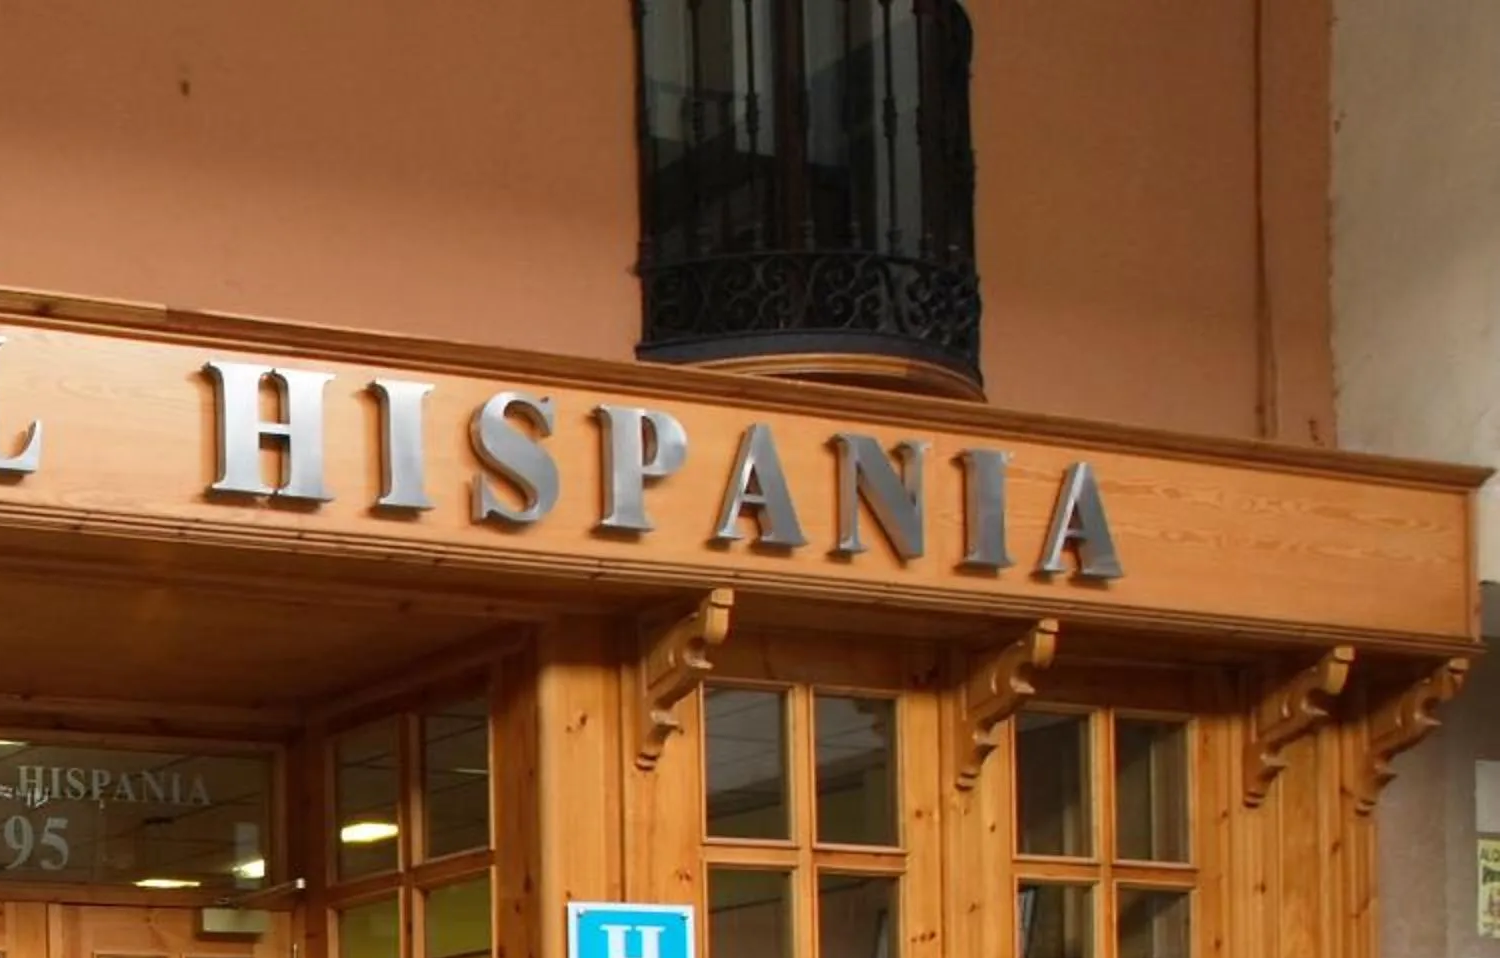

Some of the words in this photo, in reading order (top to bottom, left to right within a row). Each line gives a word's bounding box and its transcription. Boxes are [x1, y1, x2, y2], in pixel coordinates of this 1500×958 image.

[202, 359, 1122, 581] HISPANIA
[16, 764, 211, 806] HISPANIA
[3, 815, 70, 871] 95
